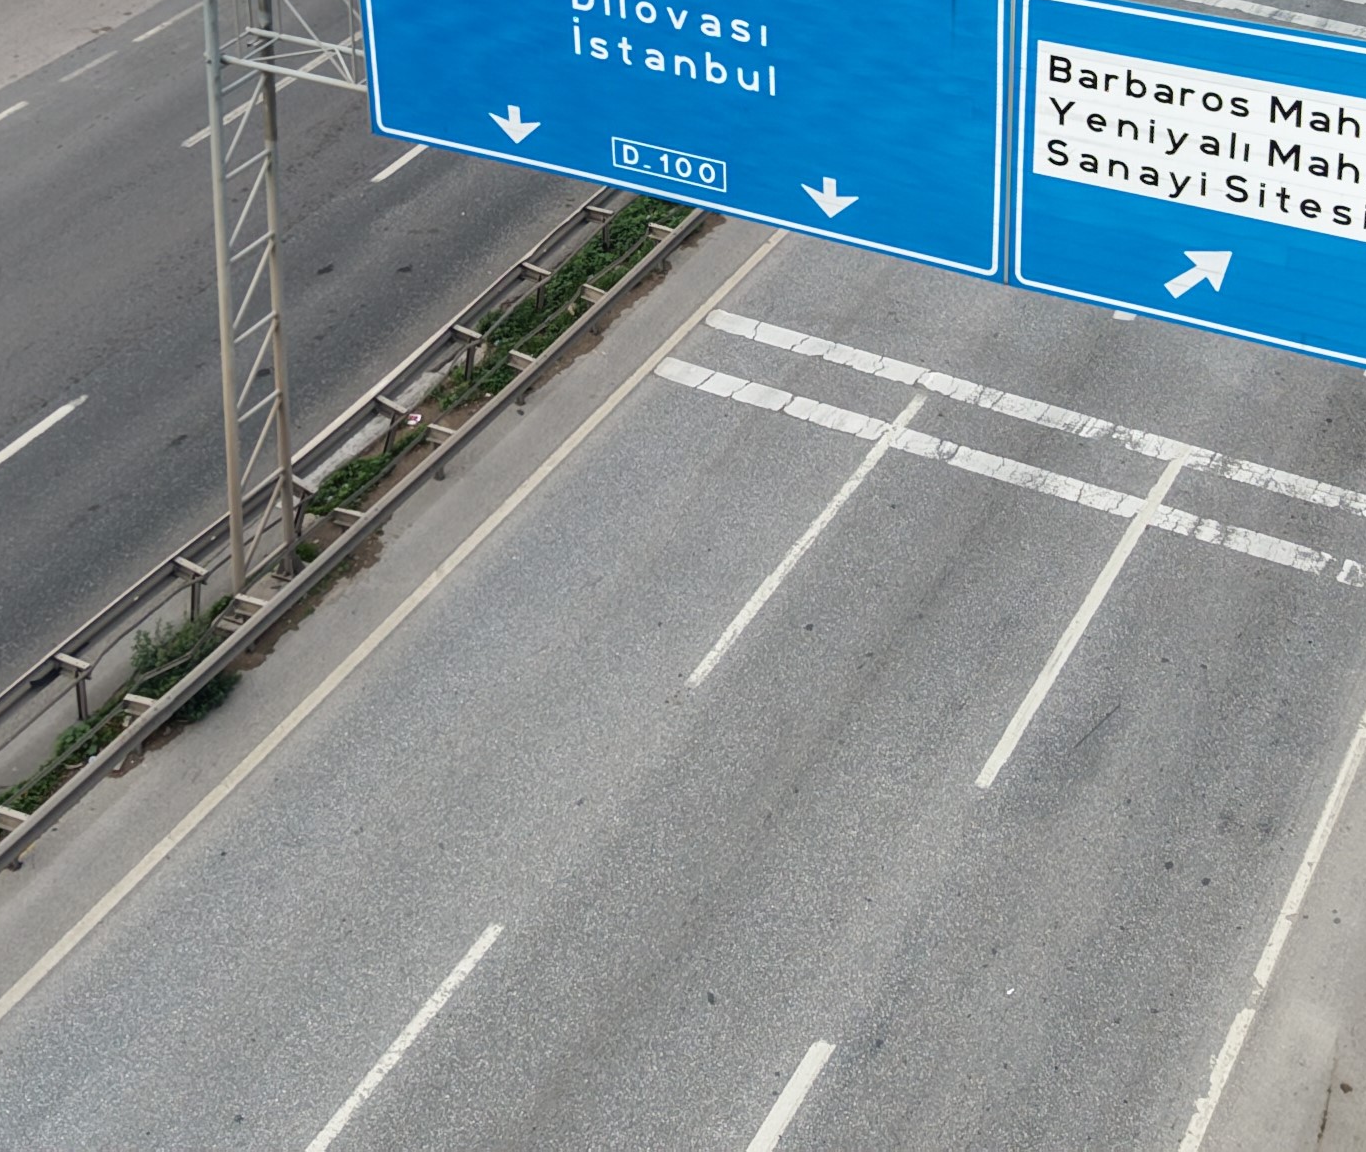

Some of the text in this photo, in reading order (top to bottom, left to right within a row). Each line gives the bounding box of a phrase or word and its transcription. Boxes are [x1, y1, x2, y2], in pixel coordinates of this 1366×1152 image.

[572, 16, 776, 97] İstanbul
[1049, 54, 1251, 118] Barbaros
[1049, 96, 1251, 163] Yeniyalı
[1046, 139, 1208, 199] Sanayi
